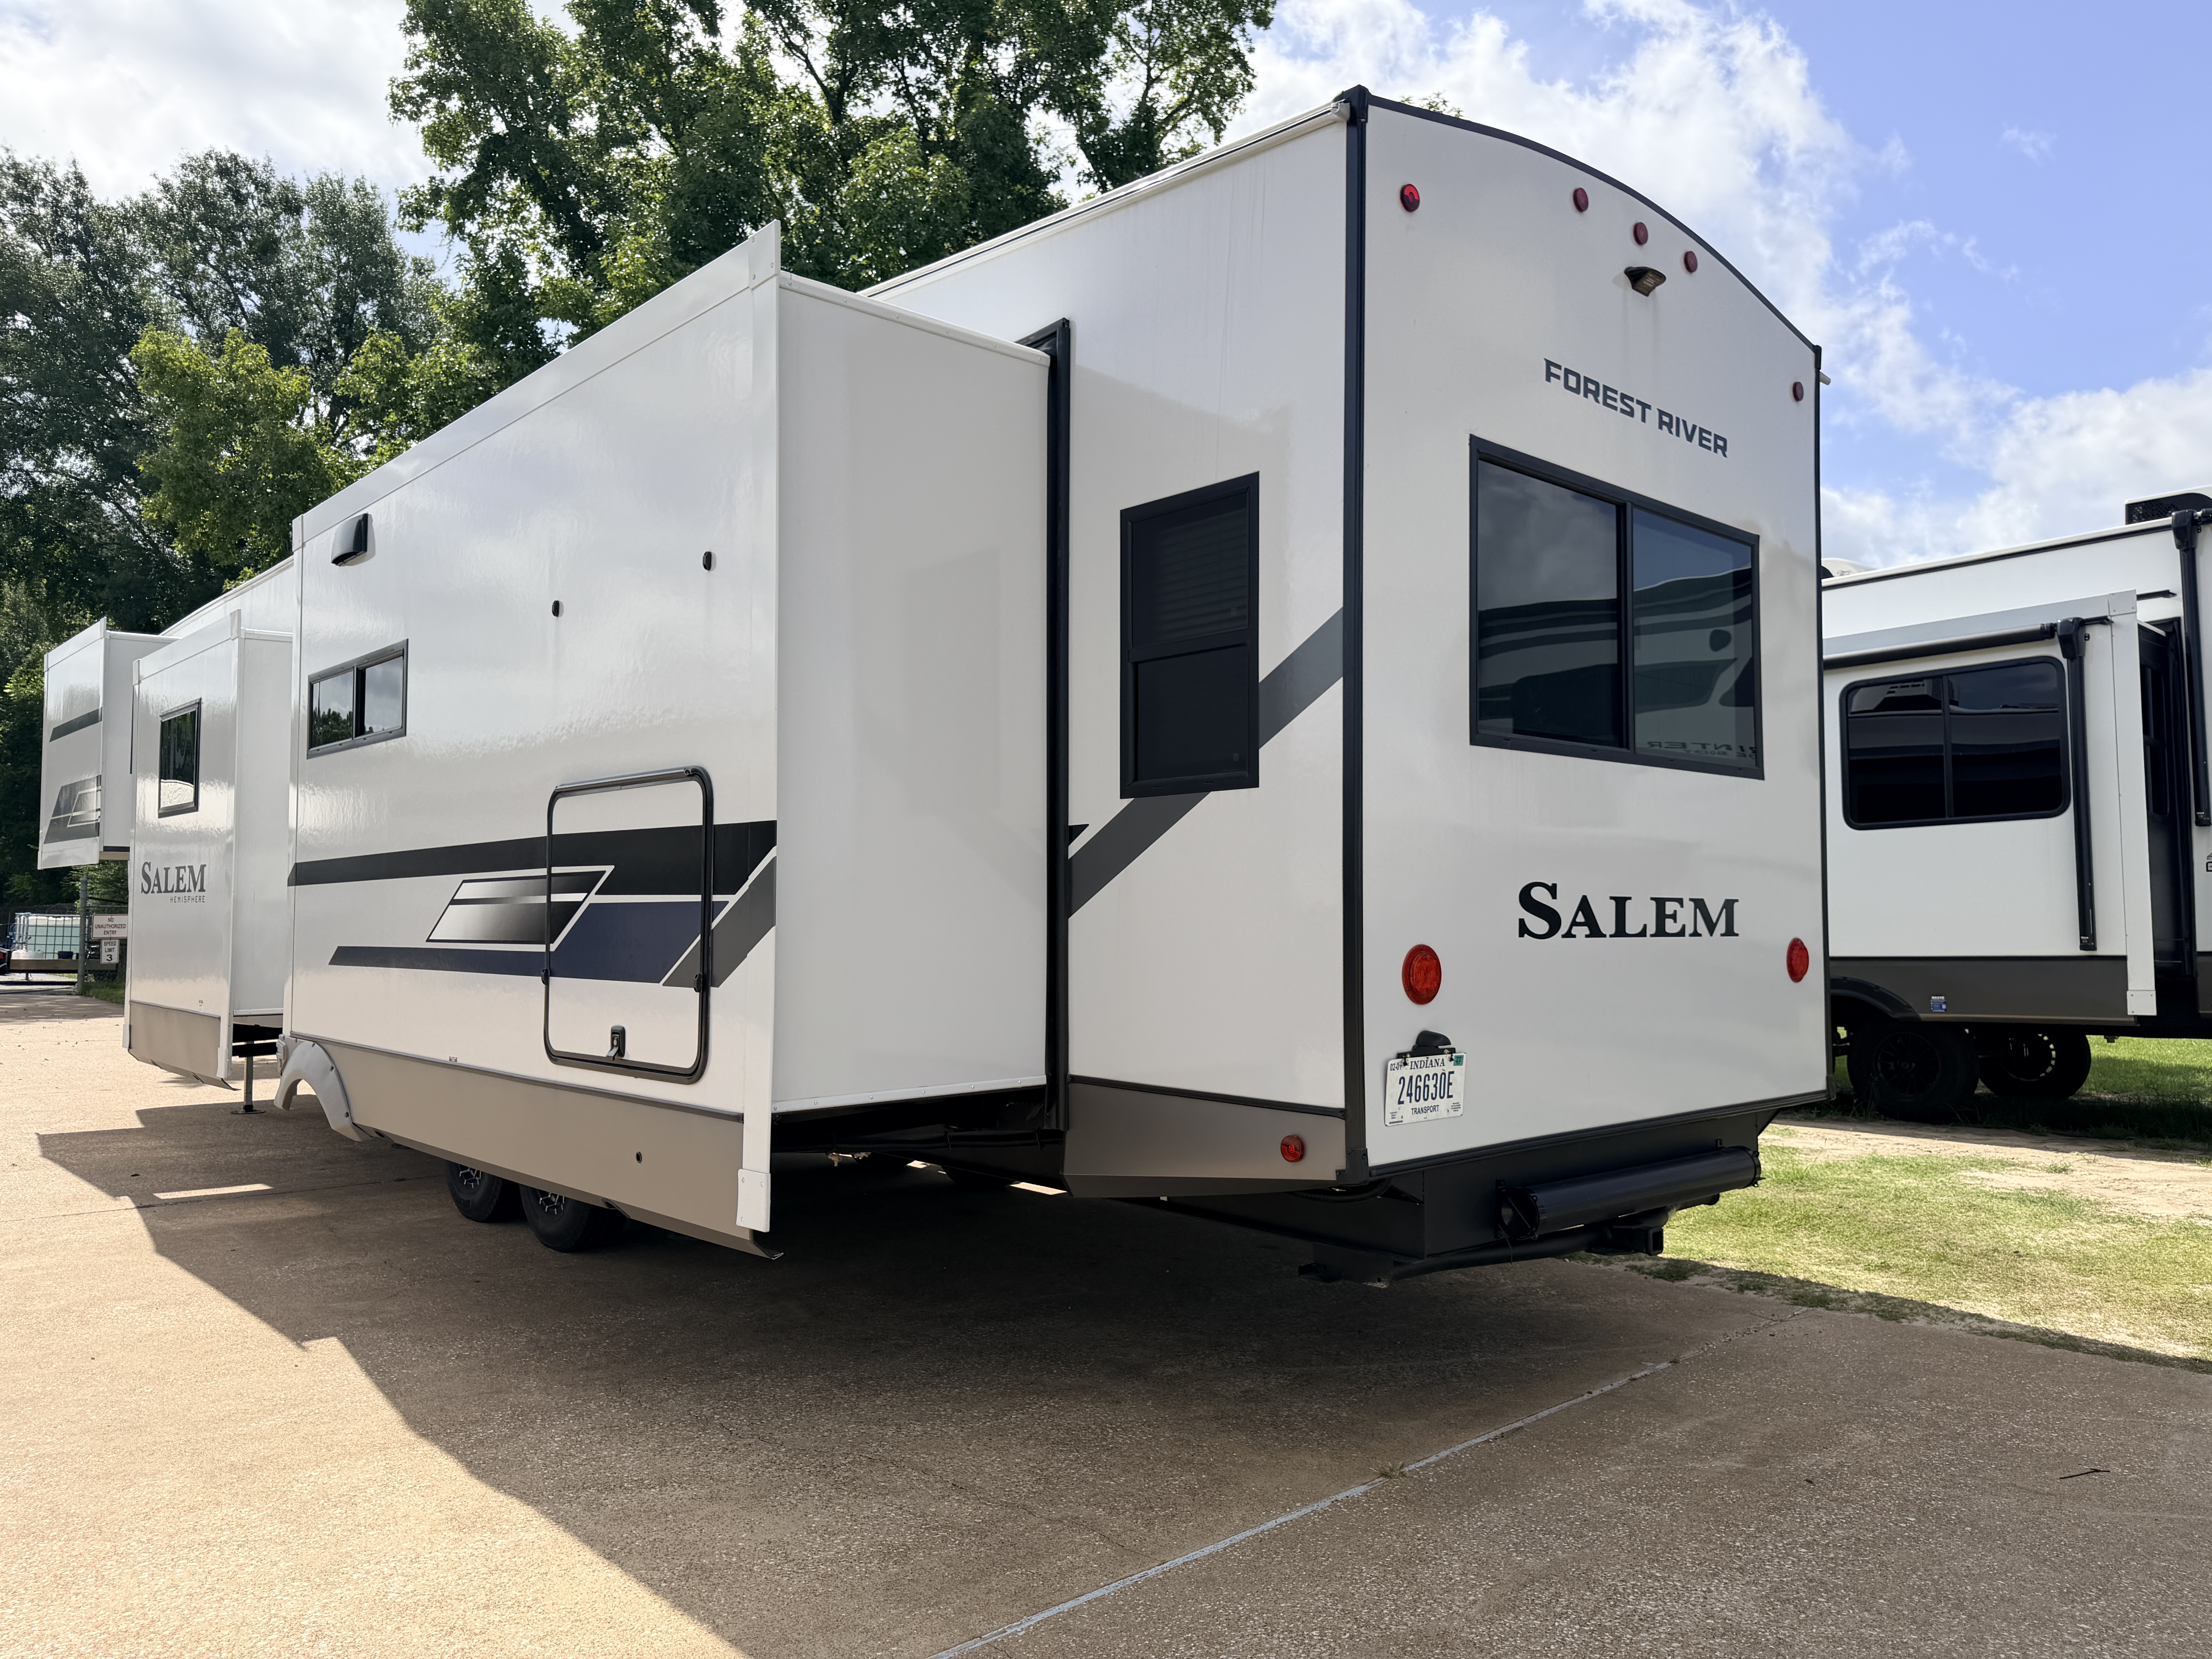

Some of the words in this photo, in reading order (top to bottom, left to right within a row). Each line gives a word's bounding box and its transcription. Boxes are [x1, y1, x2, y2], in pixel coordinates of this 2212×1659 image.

[1544, 357, 1652, 424] FOREST
[1657, 408, 1728, 459] RIVER
[141, 861, 206, 895] SALEM
[1518, 881, 1739, 939] SALEM
[1410, 1058, 1445, 1070] INDIANA
[1398, 1071, 1455, 1105] 246630E
[1411, 1105, 1439, 1115] TRANSPORT
